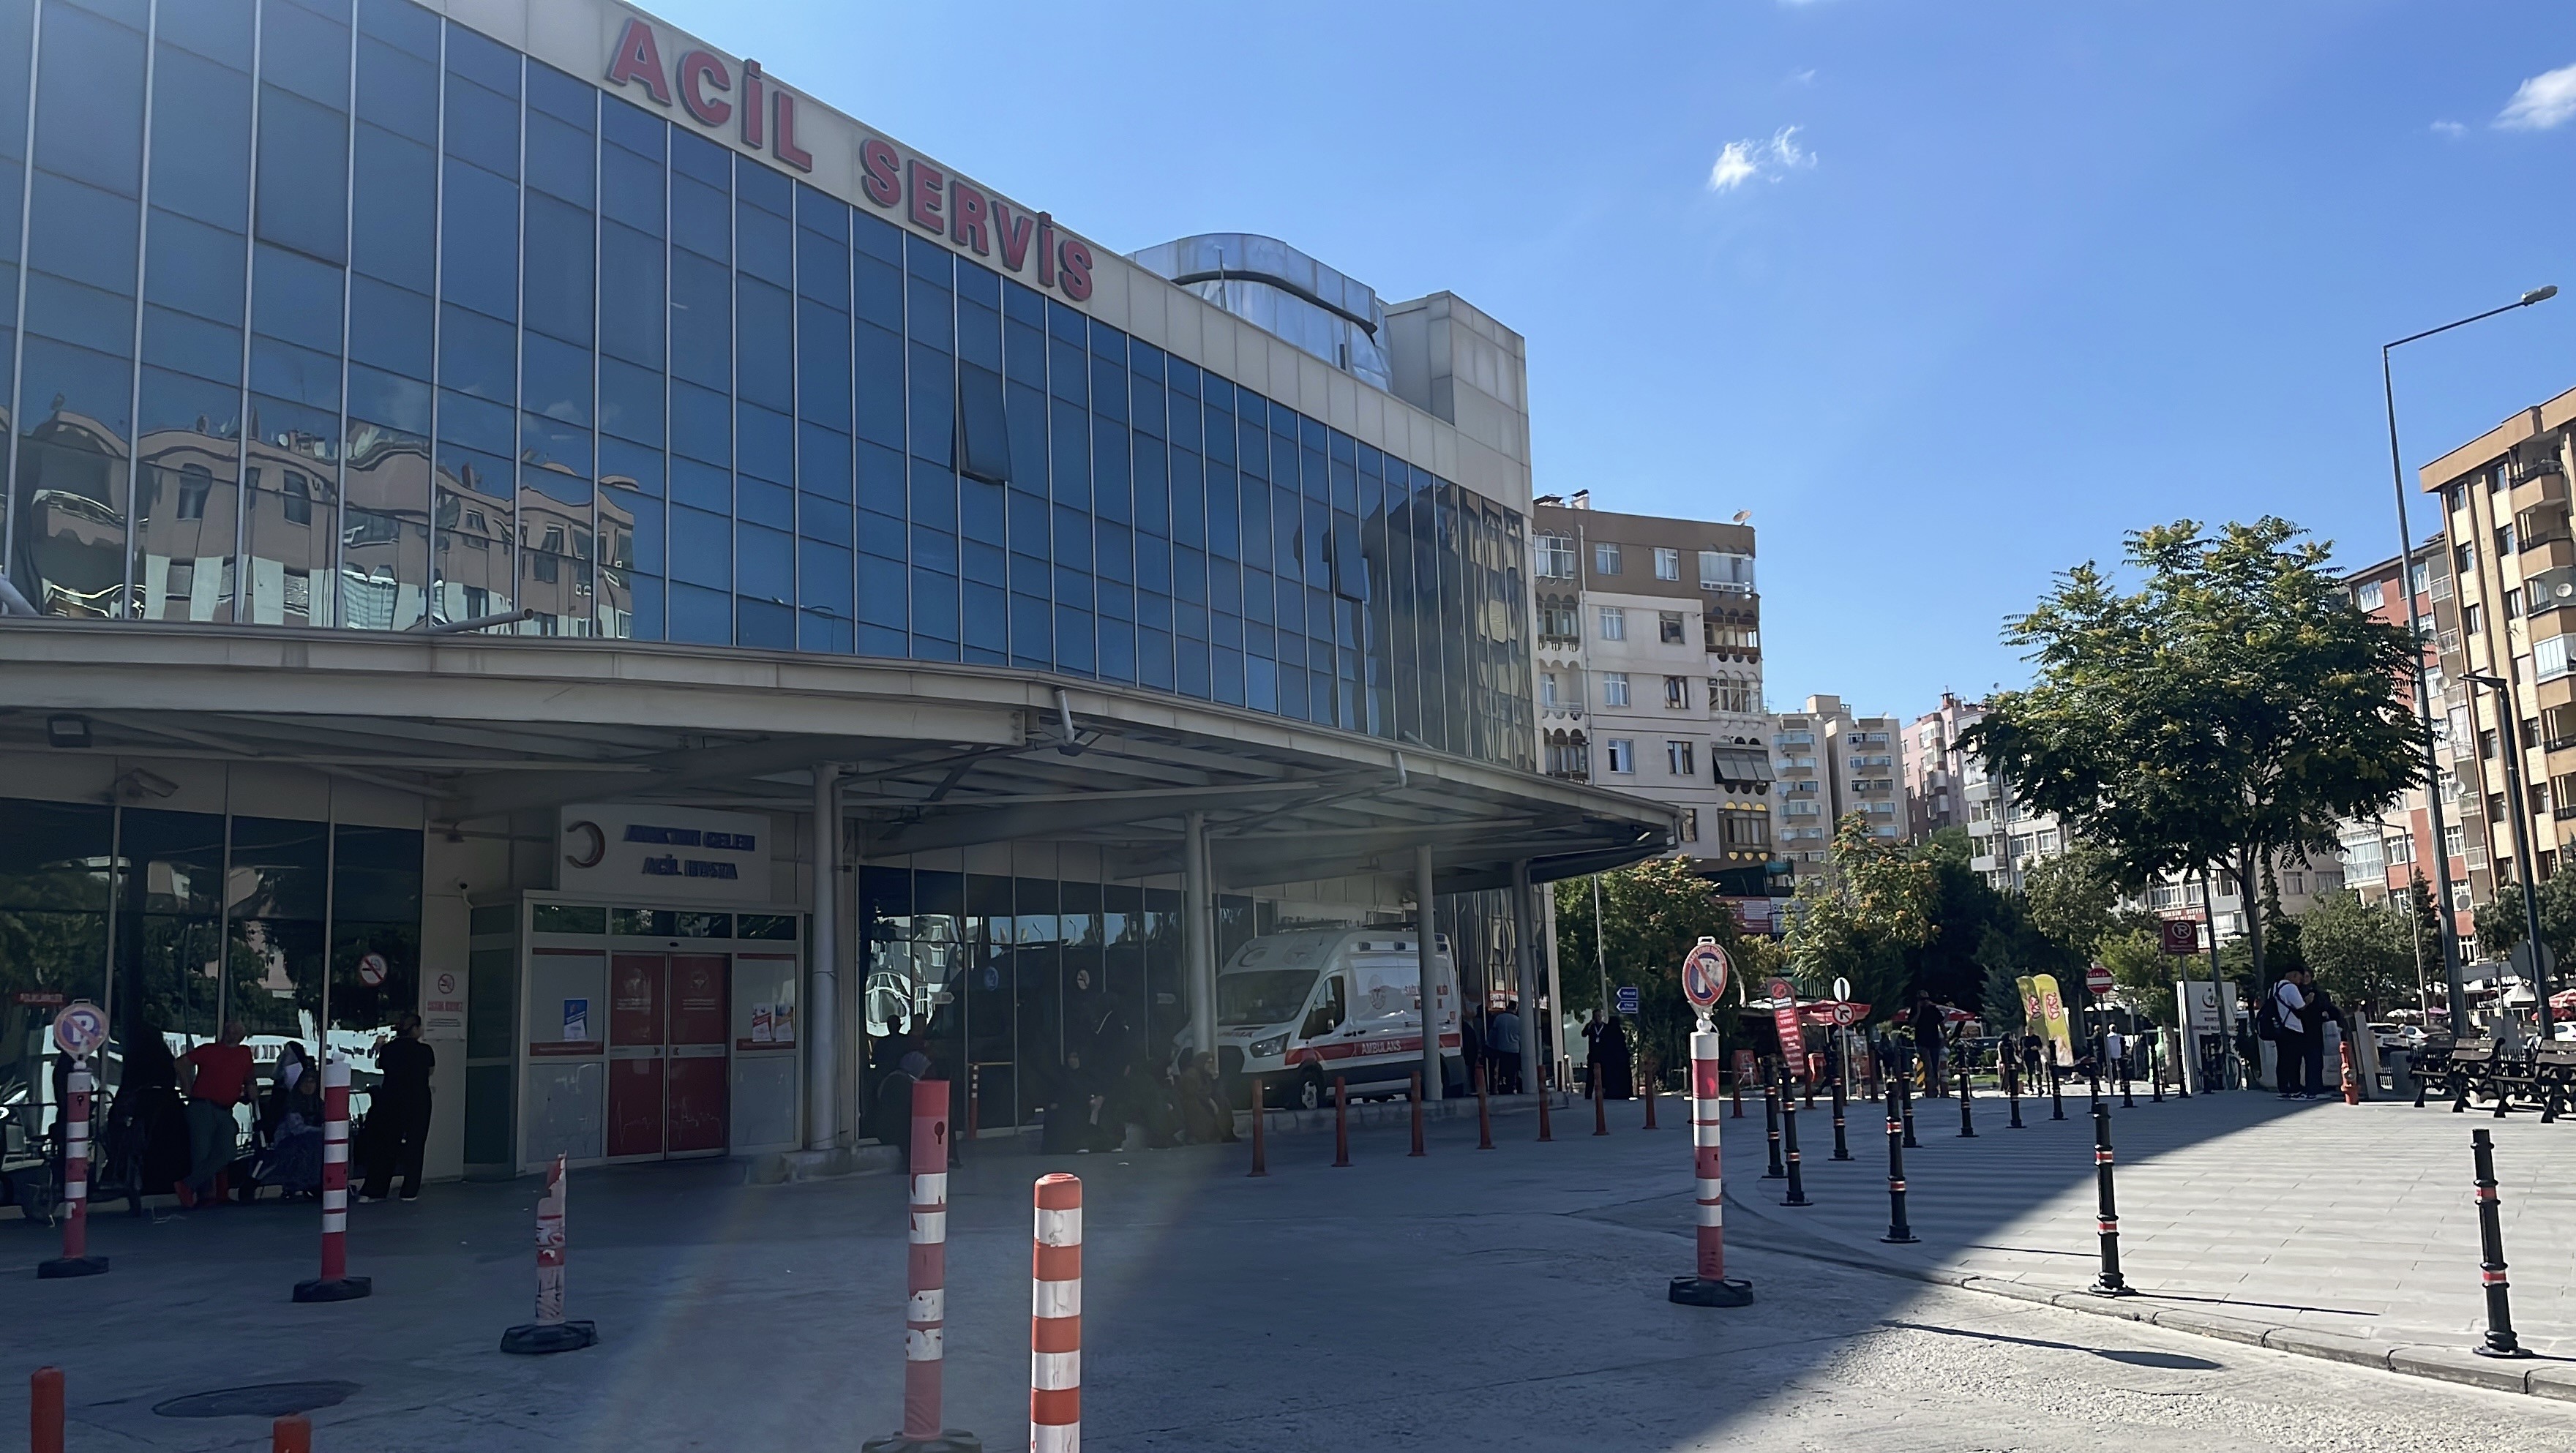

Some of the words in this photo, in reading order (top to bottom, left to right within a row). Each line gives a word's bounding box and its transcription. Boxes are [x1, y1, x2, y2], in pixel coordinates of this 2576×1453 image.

[605, 17, 812, 173] ACİL
[860, 139, 1093, 301] SERVİS
[1361, 1040, 1401, 1055] AMBULANS
